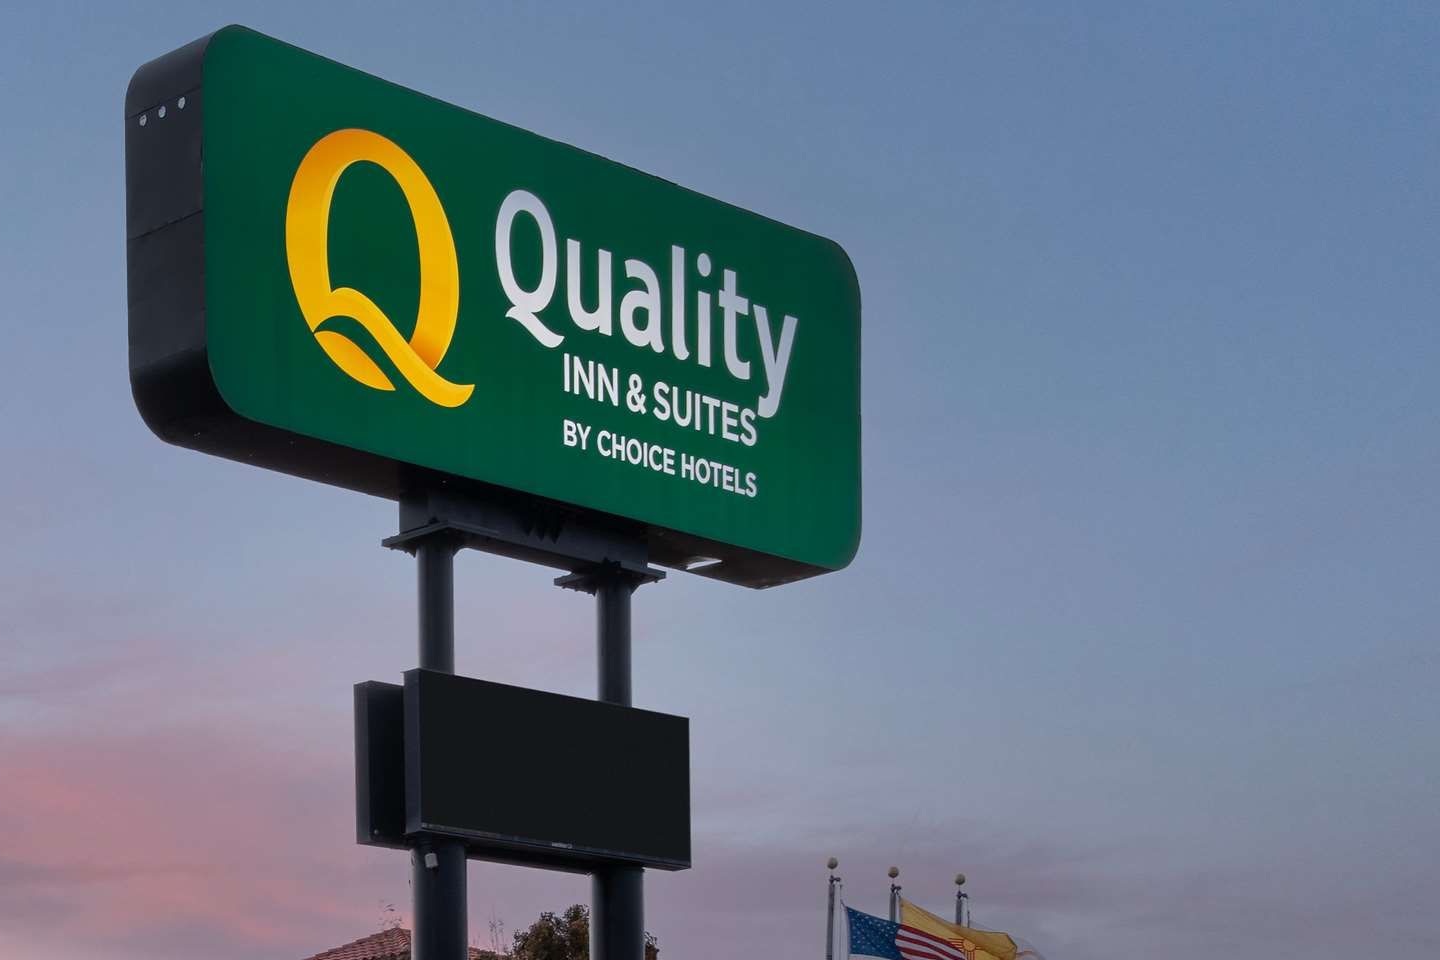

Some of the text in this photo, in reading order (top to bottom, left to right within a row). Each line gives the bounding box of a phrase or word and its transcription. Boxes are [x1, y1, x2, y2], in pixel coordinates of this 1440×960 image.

[285, 127, 475, 408] Q
[496, 189, 798, 419] Quality
[564, 353, 757, 447] INN & SUITES
[564, 420, 757, 498] BY CHOICE HOTELS
